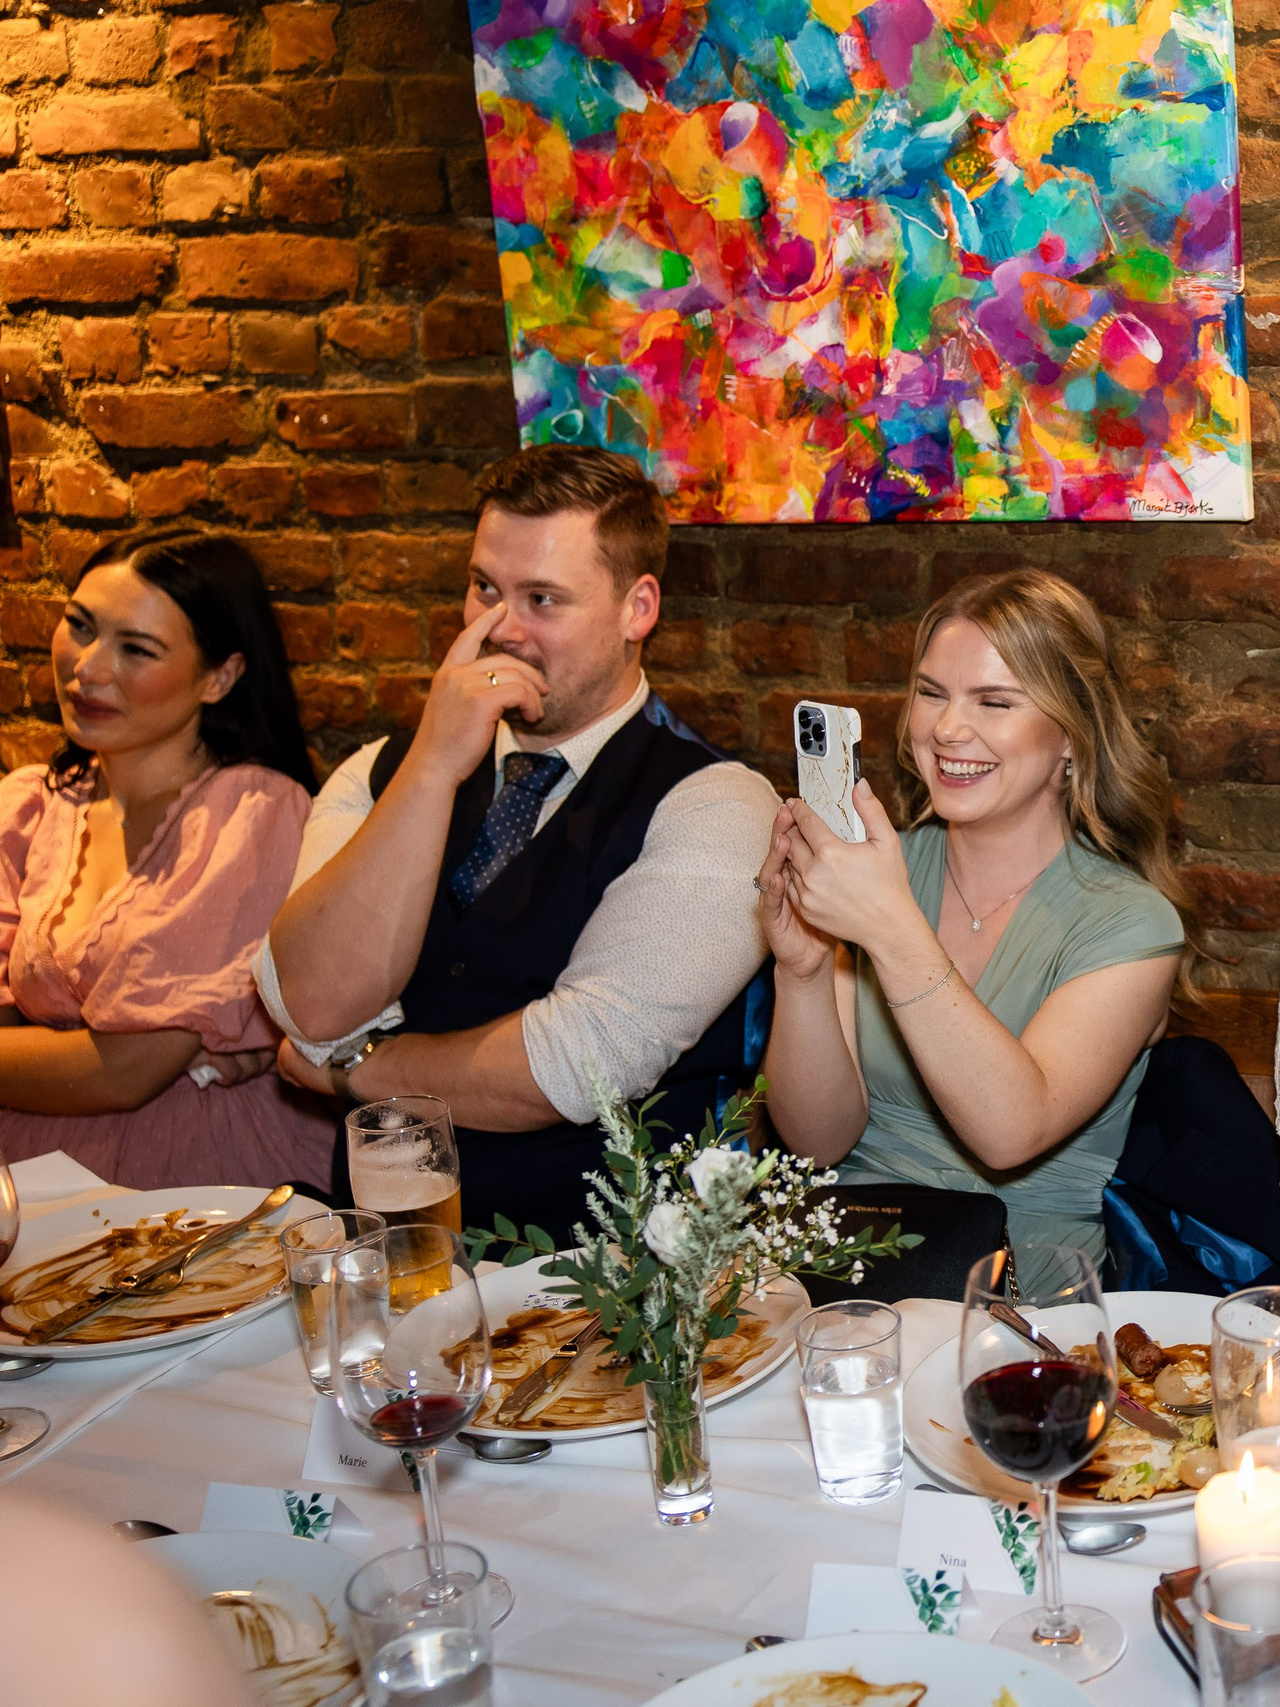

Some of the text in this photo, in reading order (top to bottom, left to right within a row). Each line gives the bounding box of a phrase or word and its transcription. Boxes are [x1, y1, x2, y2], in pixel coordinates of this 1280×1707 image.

[1129, 498, 1173, 517] Margit
[338, 1454, 368, 1468] Marie
[939, 1553, 967, 1568] Nina
